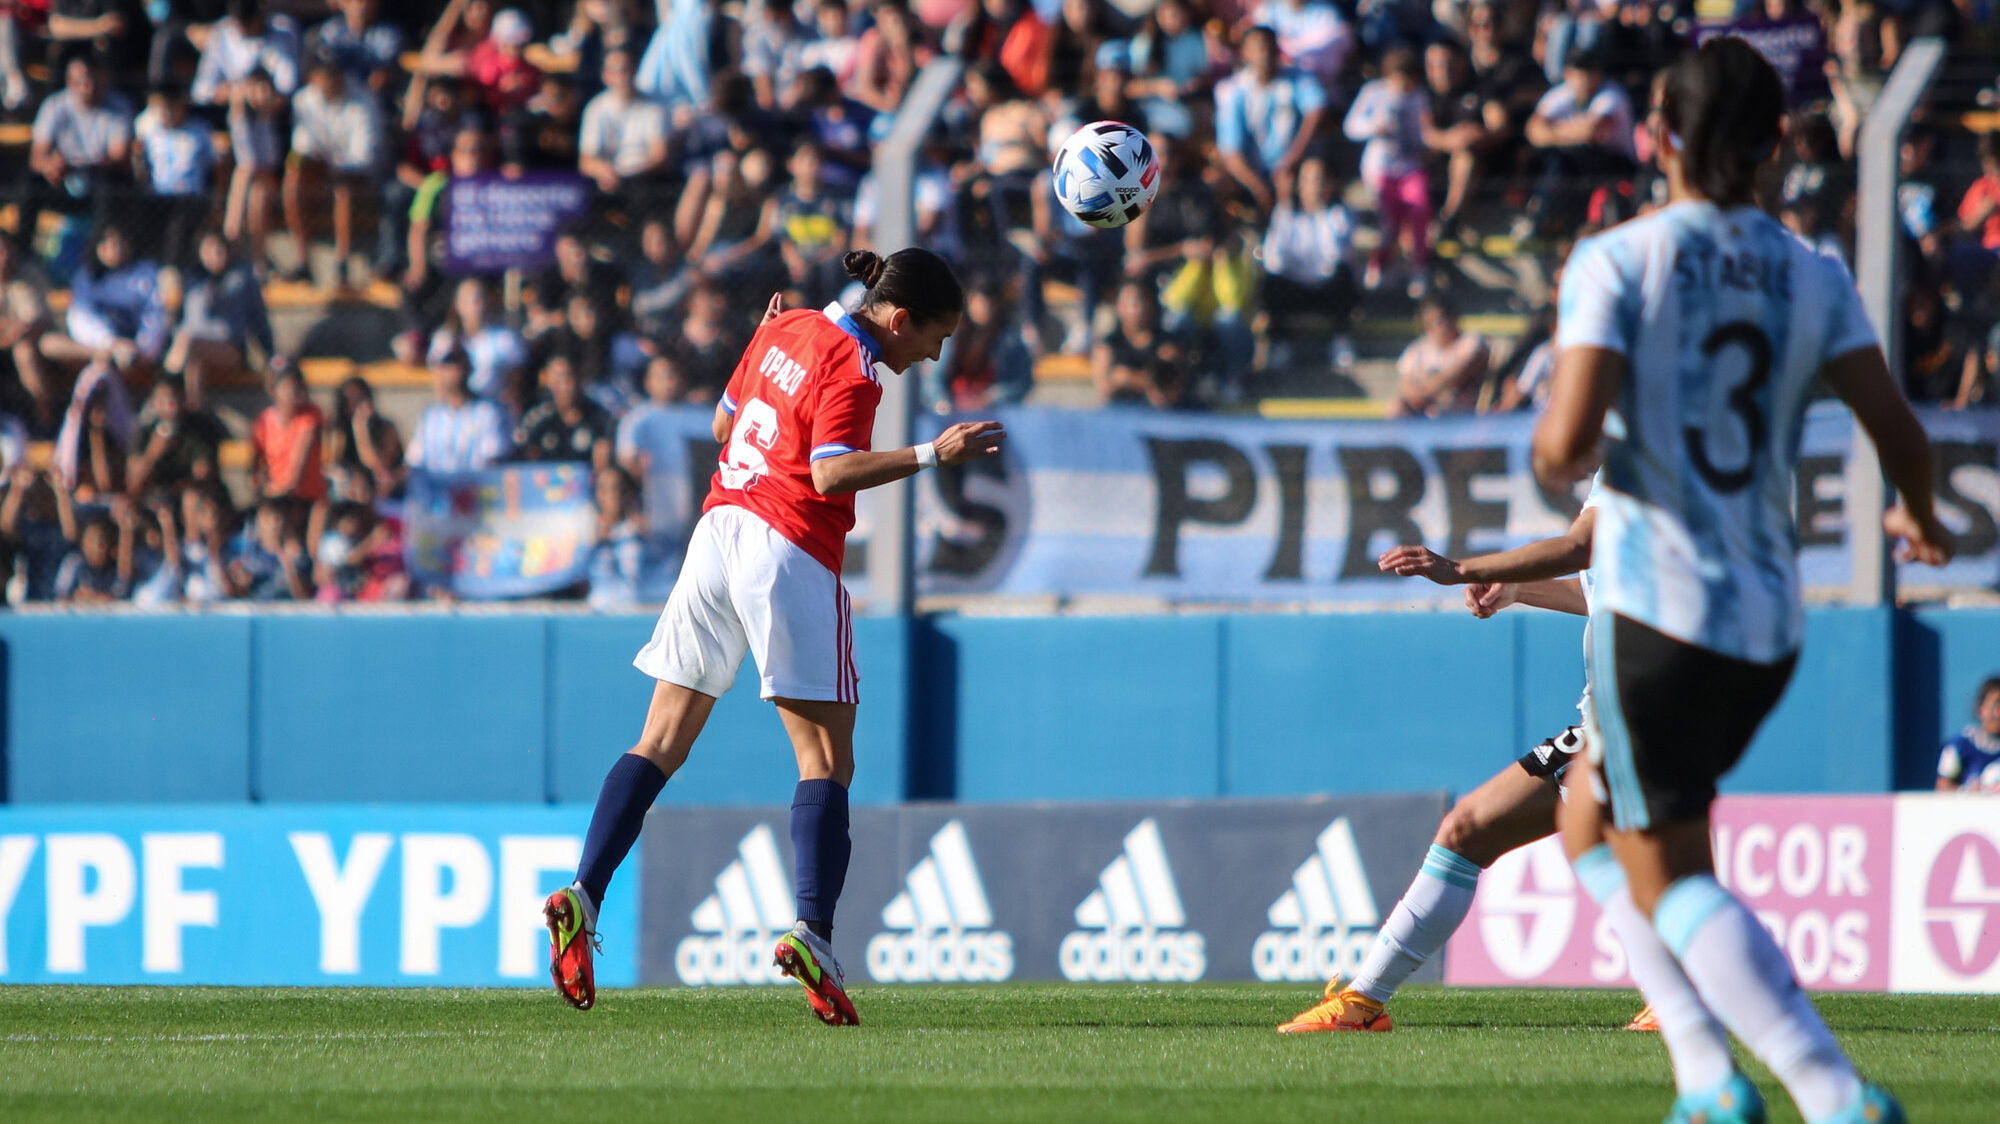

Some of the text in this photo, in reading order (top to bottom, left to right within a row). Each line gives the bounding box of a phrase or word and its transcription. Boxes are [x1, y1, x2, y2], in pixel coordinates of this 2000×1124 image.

[759, 345, 807, 397] OPAZO
[1683, 320, 1773, 495] 3
[718, 397, 780, 492] 6
[1141, 437, 1588, 582] PIBE
[288, 832, 580, 978] YPF
[674, 928, 802, 986] adid
[866, 924, 1015, 983] adidas
[1058, 923, 1207, 982] adidas
[1252, 923, 1378, 982] adida
